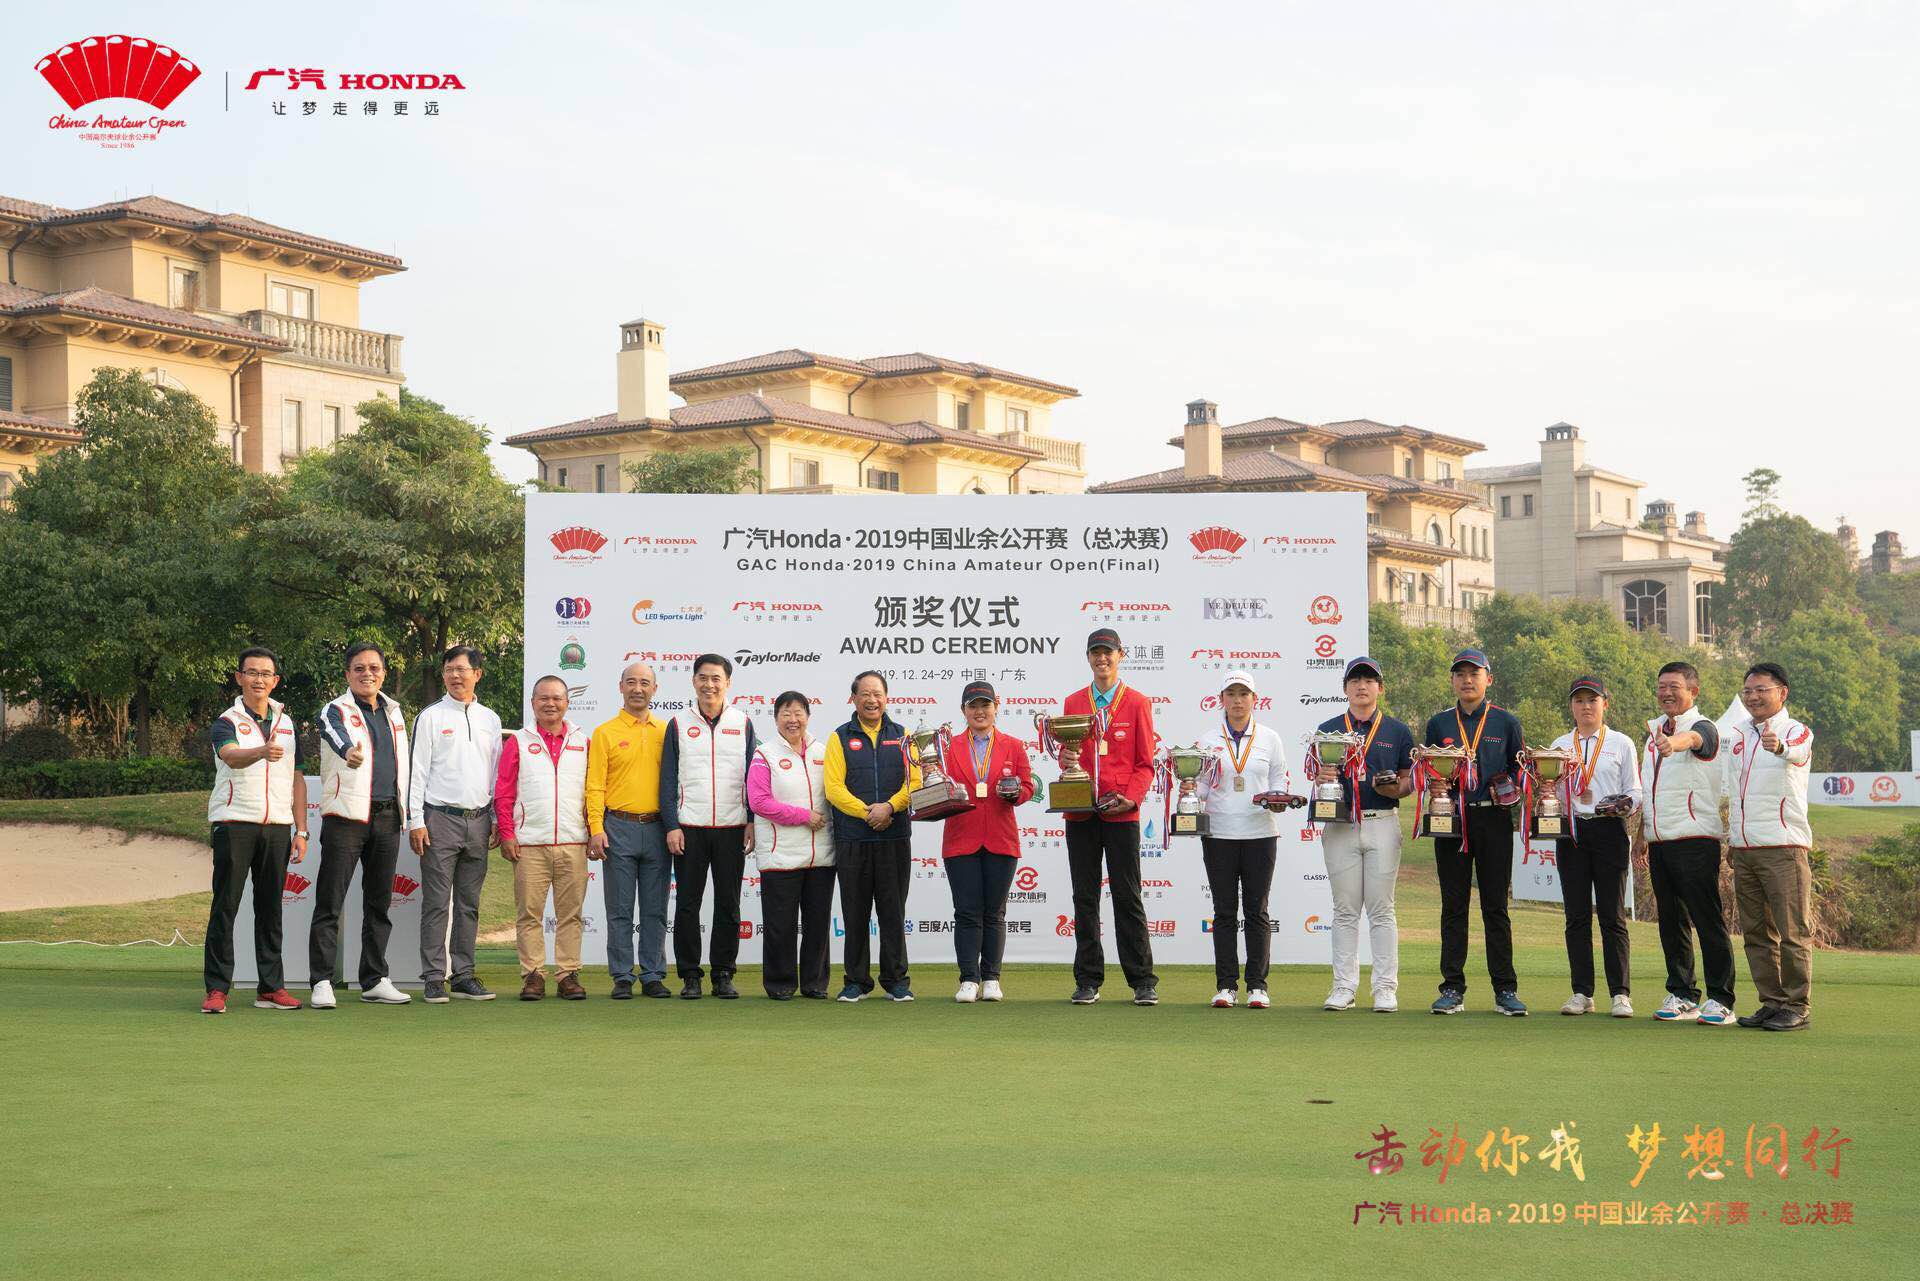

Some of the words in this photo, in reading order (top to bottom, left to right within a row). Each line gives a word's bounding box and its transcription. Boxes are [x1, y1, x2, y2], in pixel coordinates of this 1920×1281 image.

[737, 558, 777, 571] GAC
[903, 558, 956, 571] China
[964, 558, 1042, 571] Amateur
[874, 595, 1020, 628] 颁奖仪式
[1119, 603, 1172, 611] HONDA
[659, 613, 683, 621] Sports
[839, 637, 925, 654] AWARD
[932, 637, 1060, 654] CEREMONY
[734, 649, 820, 666] TaylorMade
[1300, 695, 1348, 705] TaylorMad
